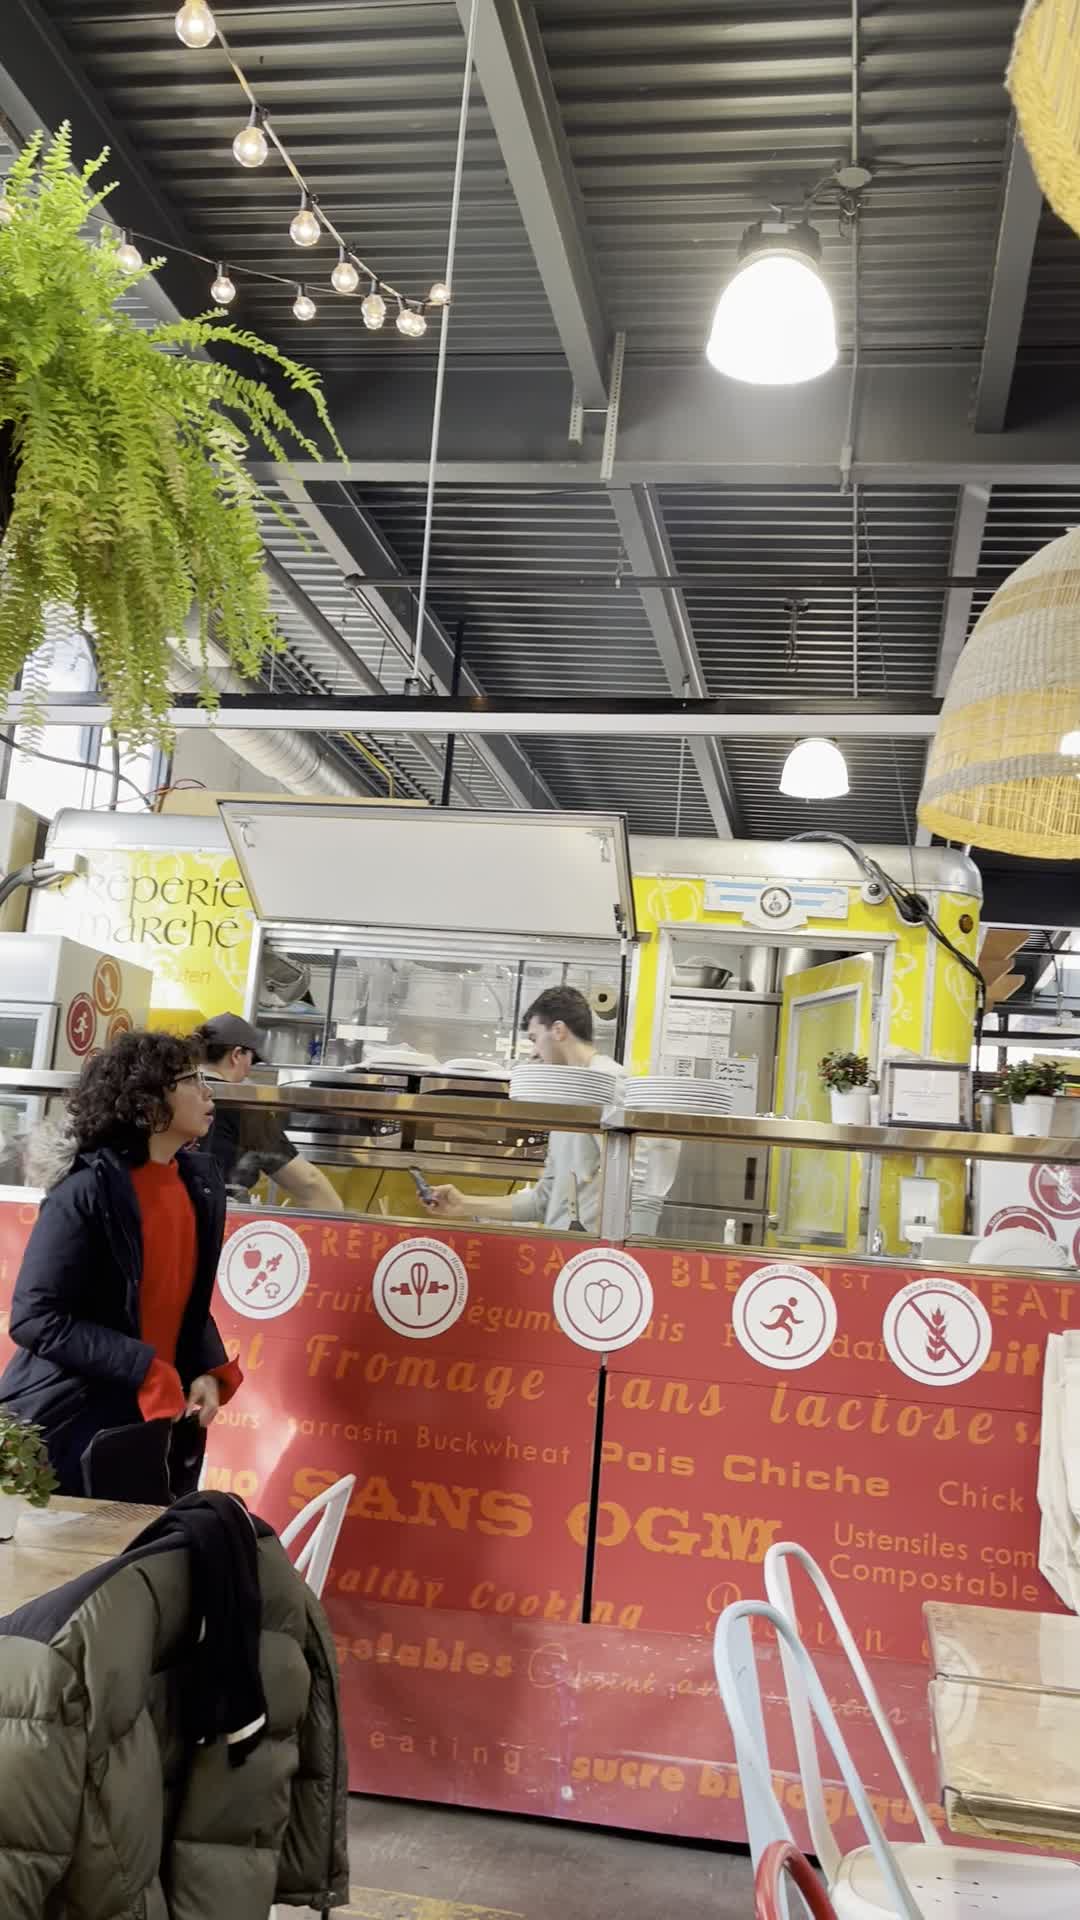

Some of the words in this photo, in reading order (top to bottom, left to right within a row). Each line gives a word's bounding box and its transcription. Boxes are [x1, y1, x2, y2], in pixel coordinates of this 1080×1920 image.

[306, 1334, 547, 1409] Fromage
[770, 1382, 995, 1445] lactose
[416, 1425, 571, 1466] Buckwheat
[600, 1440, 695, 1477] Pois
[723, 1454, 889, 1497] Chiche
[939, 1481, 1025, 1513] Chick
[287, 1467, 533, 1537] SANS
[566, 1501, 782, 1564] OGM
[834, 1521, 968, 1562] Ustensiles
[469, 1581, 645, 1630] Cooking
[829, 1554, 1040, 1602] Compostable
[571, 1756, 685, 1792] sucre
[699, 1764, 946, 1829] bilogique
